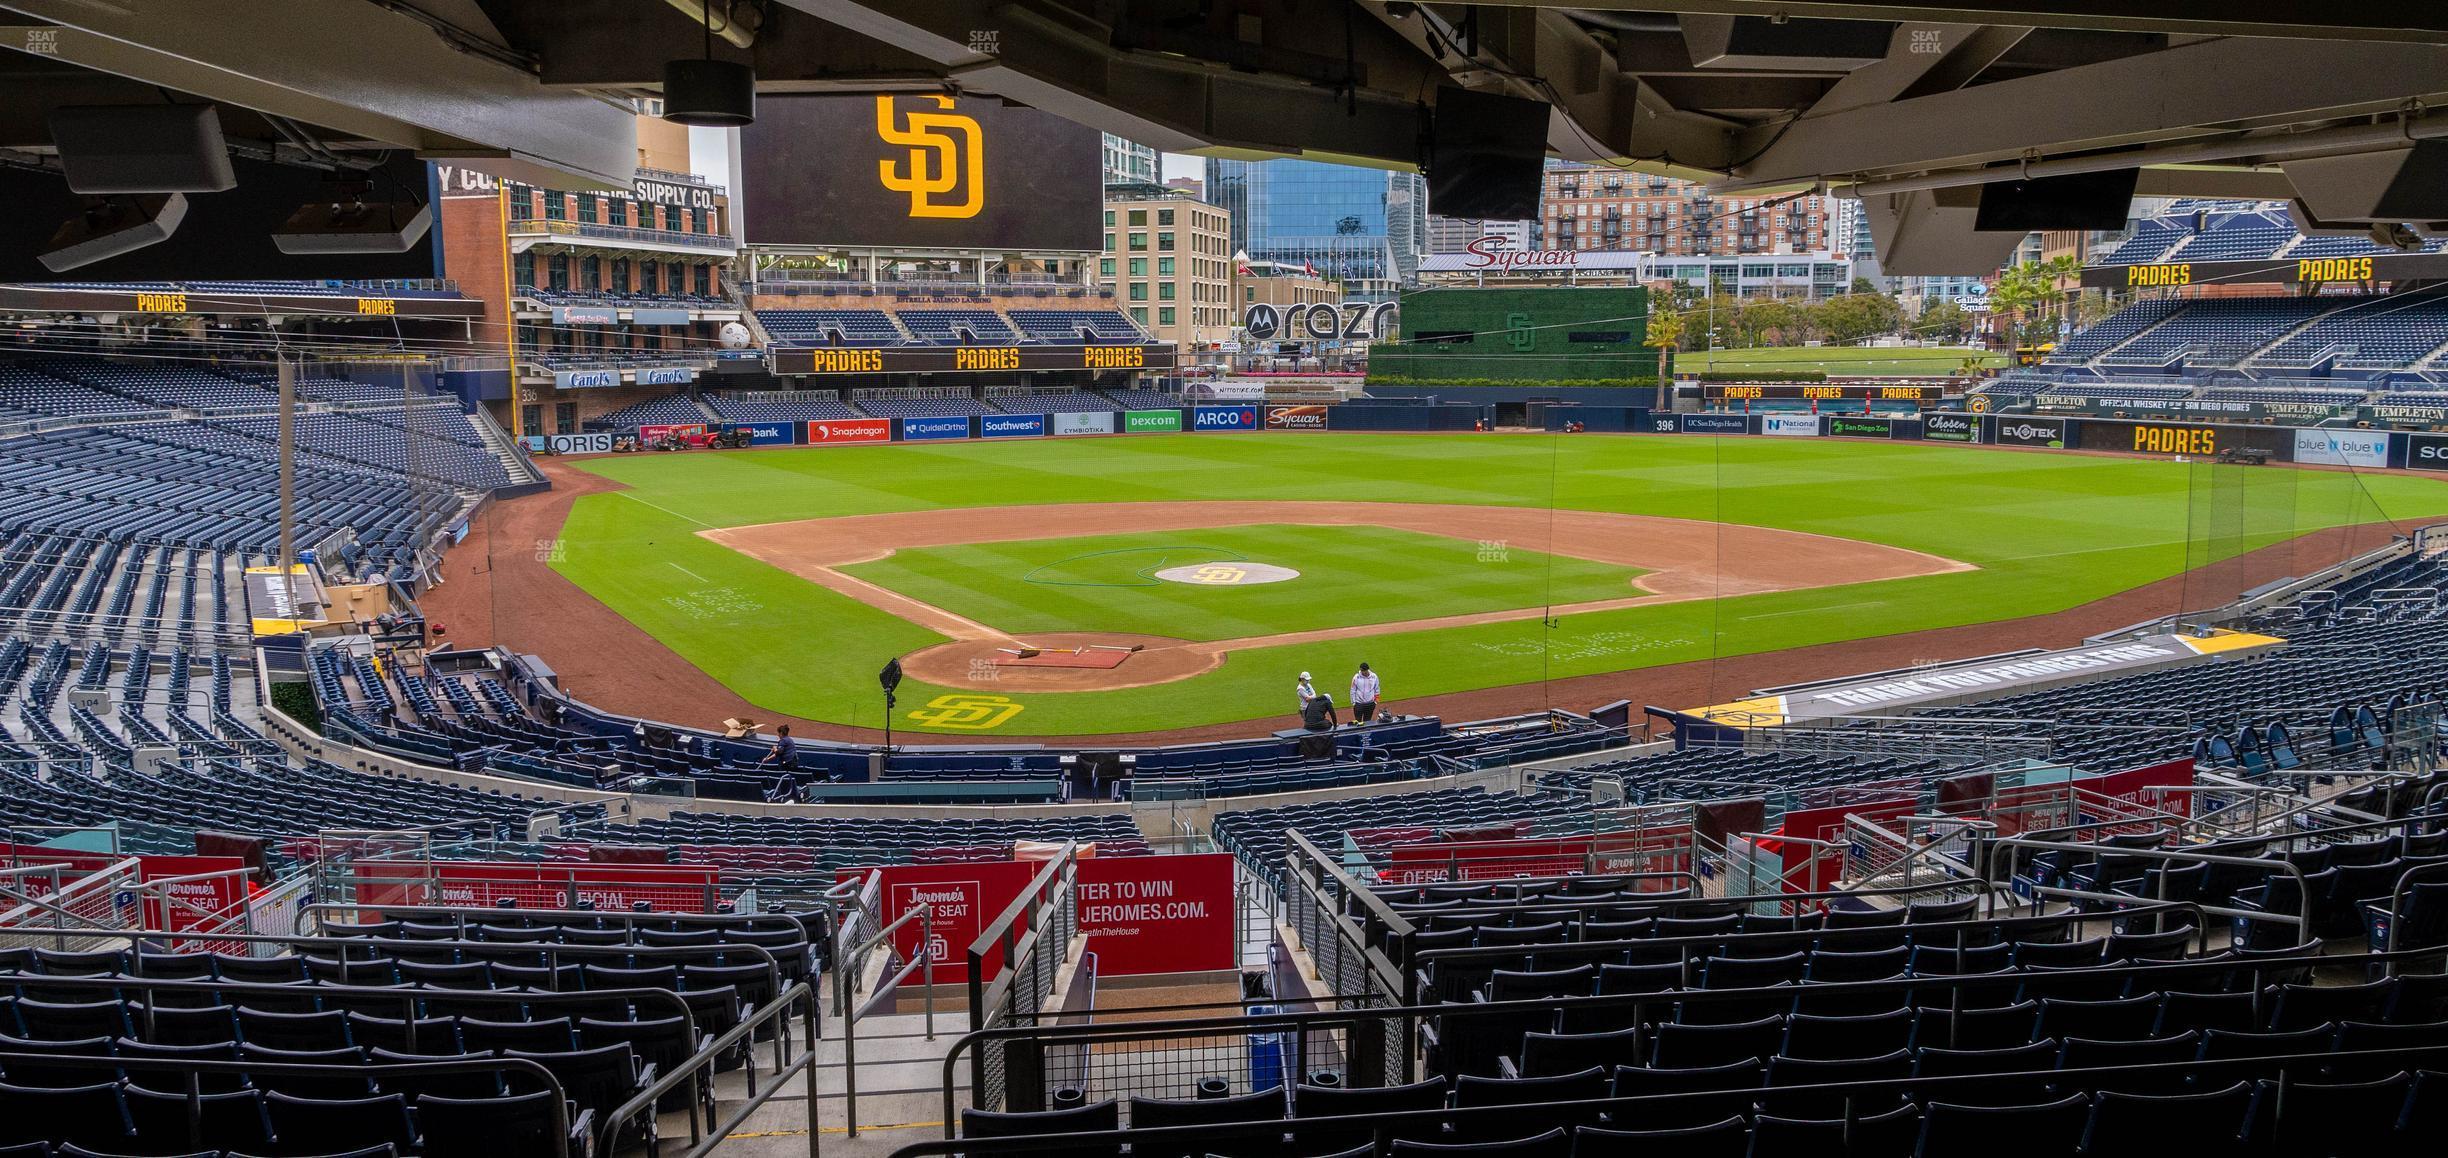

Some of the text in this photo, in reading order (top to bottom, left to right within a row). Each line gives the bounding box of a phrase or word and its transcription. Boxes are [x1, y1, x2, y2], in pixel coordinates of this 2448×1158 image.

[636, 181, 688, 206] SUPPLY
[692, 189, 714, 210] CO.
[1465, 235, 1580, 277] Sycuan
[2128, 264, 2191, 286] PADRES
[2298, 258, 2373, 282] PADRES
[137, 294, 187, 313] PADRES
[358, 299, 395, 315] PADRES
[1954, 296, 1990, 305] Gallagh
[1283, 302, 1398, 340] razr
[814, 350, 882, 372] PADRES
[956, 348, 1020, 369] PADRES
[1084, 347, 1144, 367] PADRES
[522, 389, 538, 402] 336
[1882, 388, 1921, 399] PADRES
[2035, 396, 2087, 406] TEMPLETON
[2100, 399, 2133, 408] OFFICIAL
[2133, 400, 2167, 409] WHISKEY
[2185, 401, 2199, 410] SAN
[2200, 402, 2221, 411] DIEGO
[2222, 403, 2250, 412] PADRES
[2264, 403, 2330, 416] TEMPLETON
[2373, 406, 2445, 420] TEMPLETON
[1196, 412, 1239, 425] ARCO
[1269, 407, 1321, 428] Sycuan
[1697, 419, 1708, 427] San
[1724, 420, 1743, 428] Health
[1928, 416, 1969, 430] Chosen
[752, 427, 778, 438] bank
[832, 426, 885, 438] Snapdragon
[985, 421, 1034, 431] Southwest
[1656, 420, 1674, 431] 396
[1857, 424, 1875, 433] Diego
[2002, 424, 2057, 439] EVOTEK
[555, 435, 609, 452] ORIS
[2134, 425, 2215, 455] PADRES
[2298, 439, 2326, 450] blue
[2342, 439, 2371, 452] blue
[1812, 644, 2175, 706] THANK YOU PADRES FANS
[1078, 880, 1173, 900] TER TO WIN
[122, 894, 129, 903] G
[938, 904, 969, 917] SEAT
[1080, 901, 1209, 923] JEROMES.COM.
